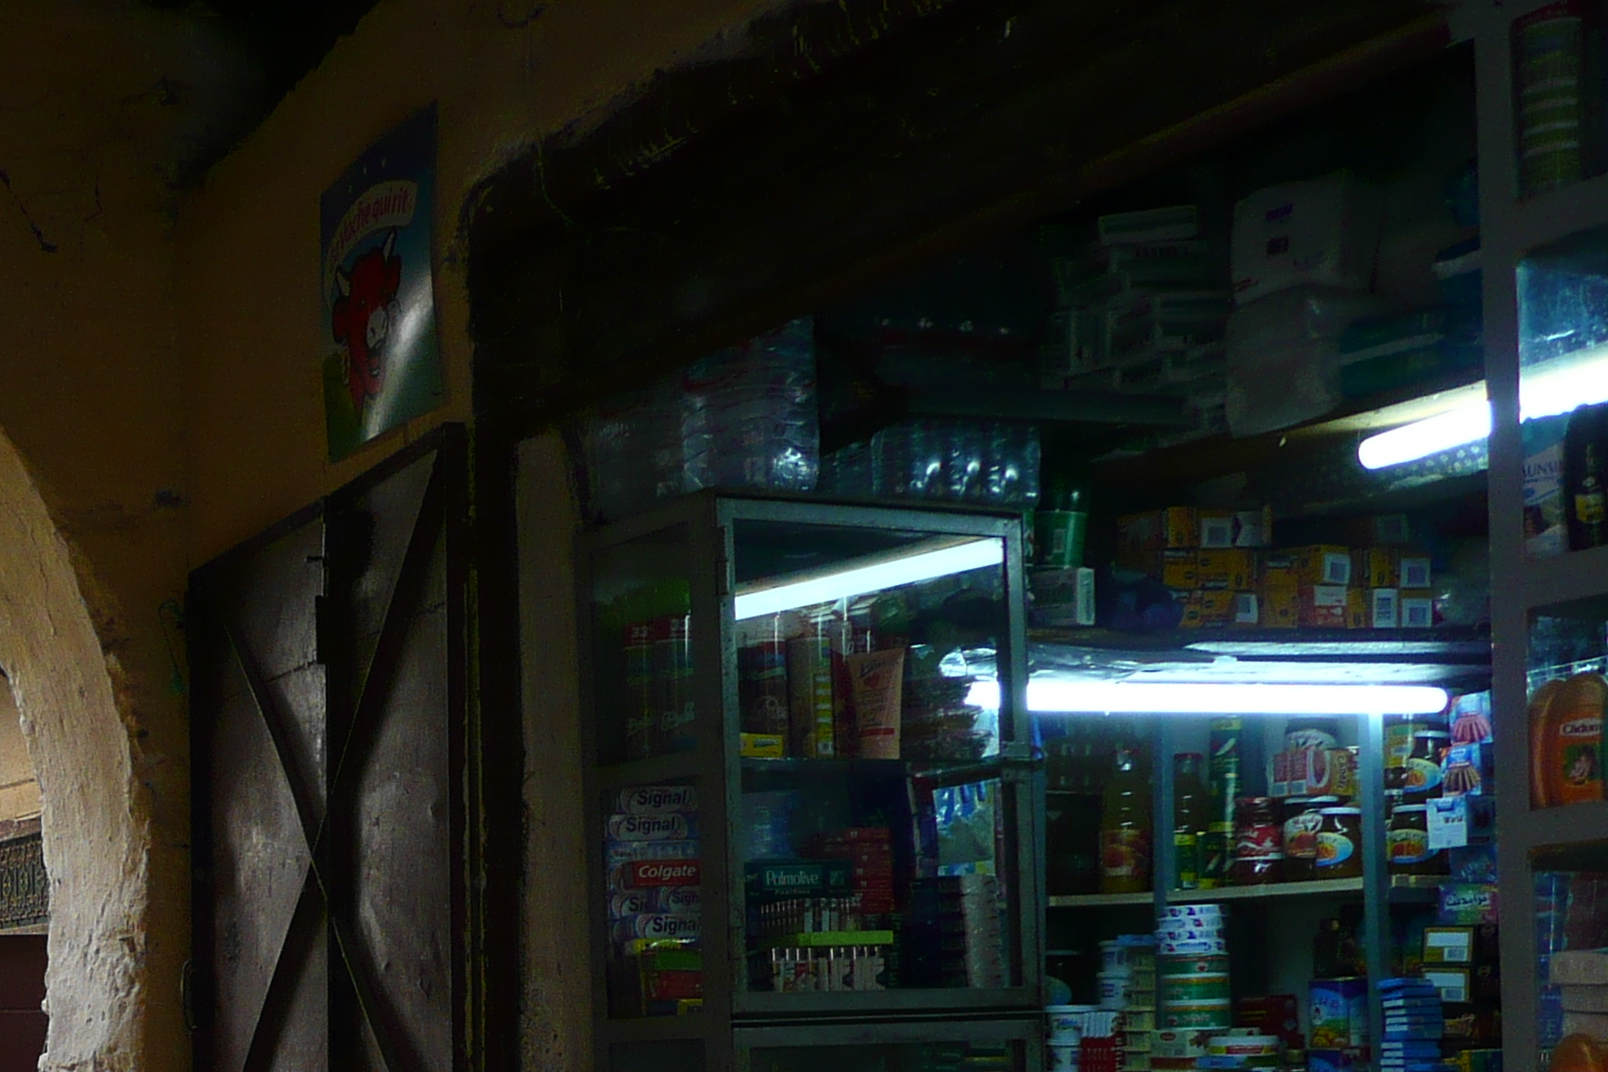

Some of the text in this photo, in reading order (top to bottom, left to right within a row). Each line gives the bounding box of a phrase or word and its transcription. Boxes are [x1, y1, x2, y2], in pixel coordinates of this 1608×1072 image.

[637, 789, 687, 808] Signal
[626, 816, 675, 835] Signal
[638, 864, 697, 882] Colgate
[765, 869, 820, 888] Palmolive
